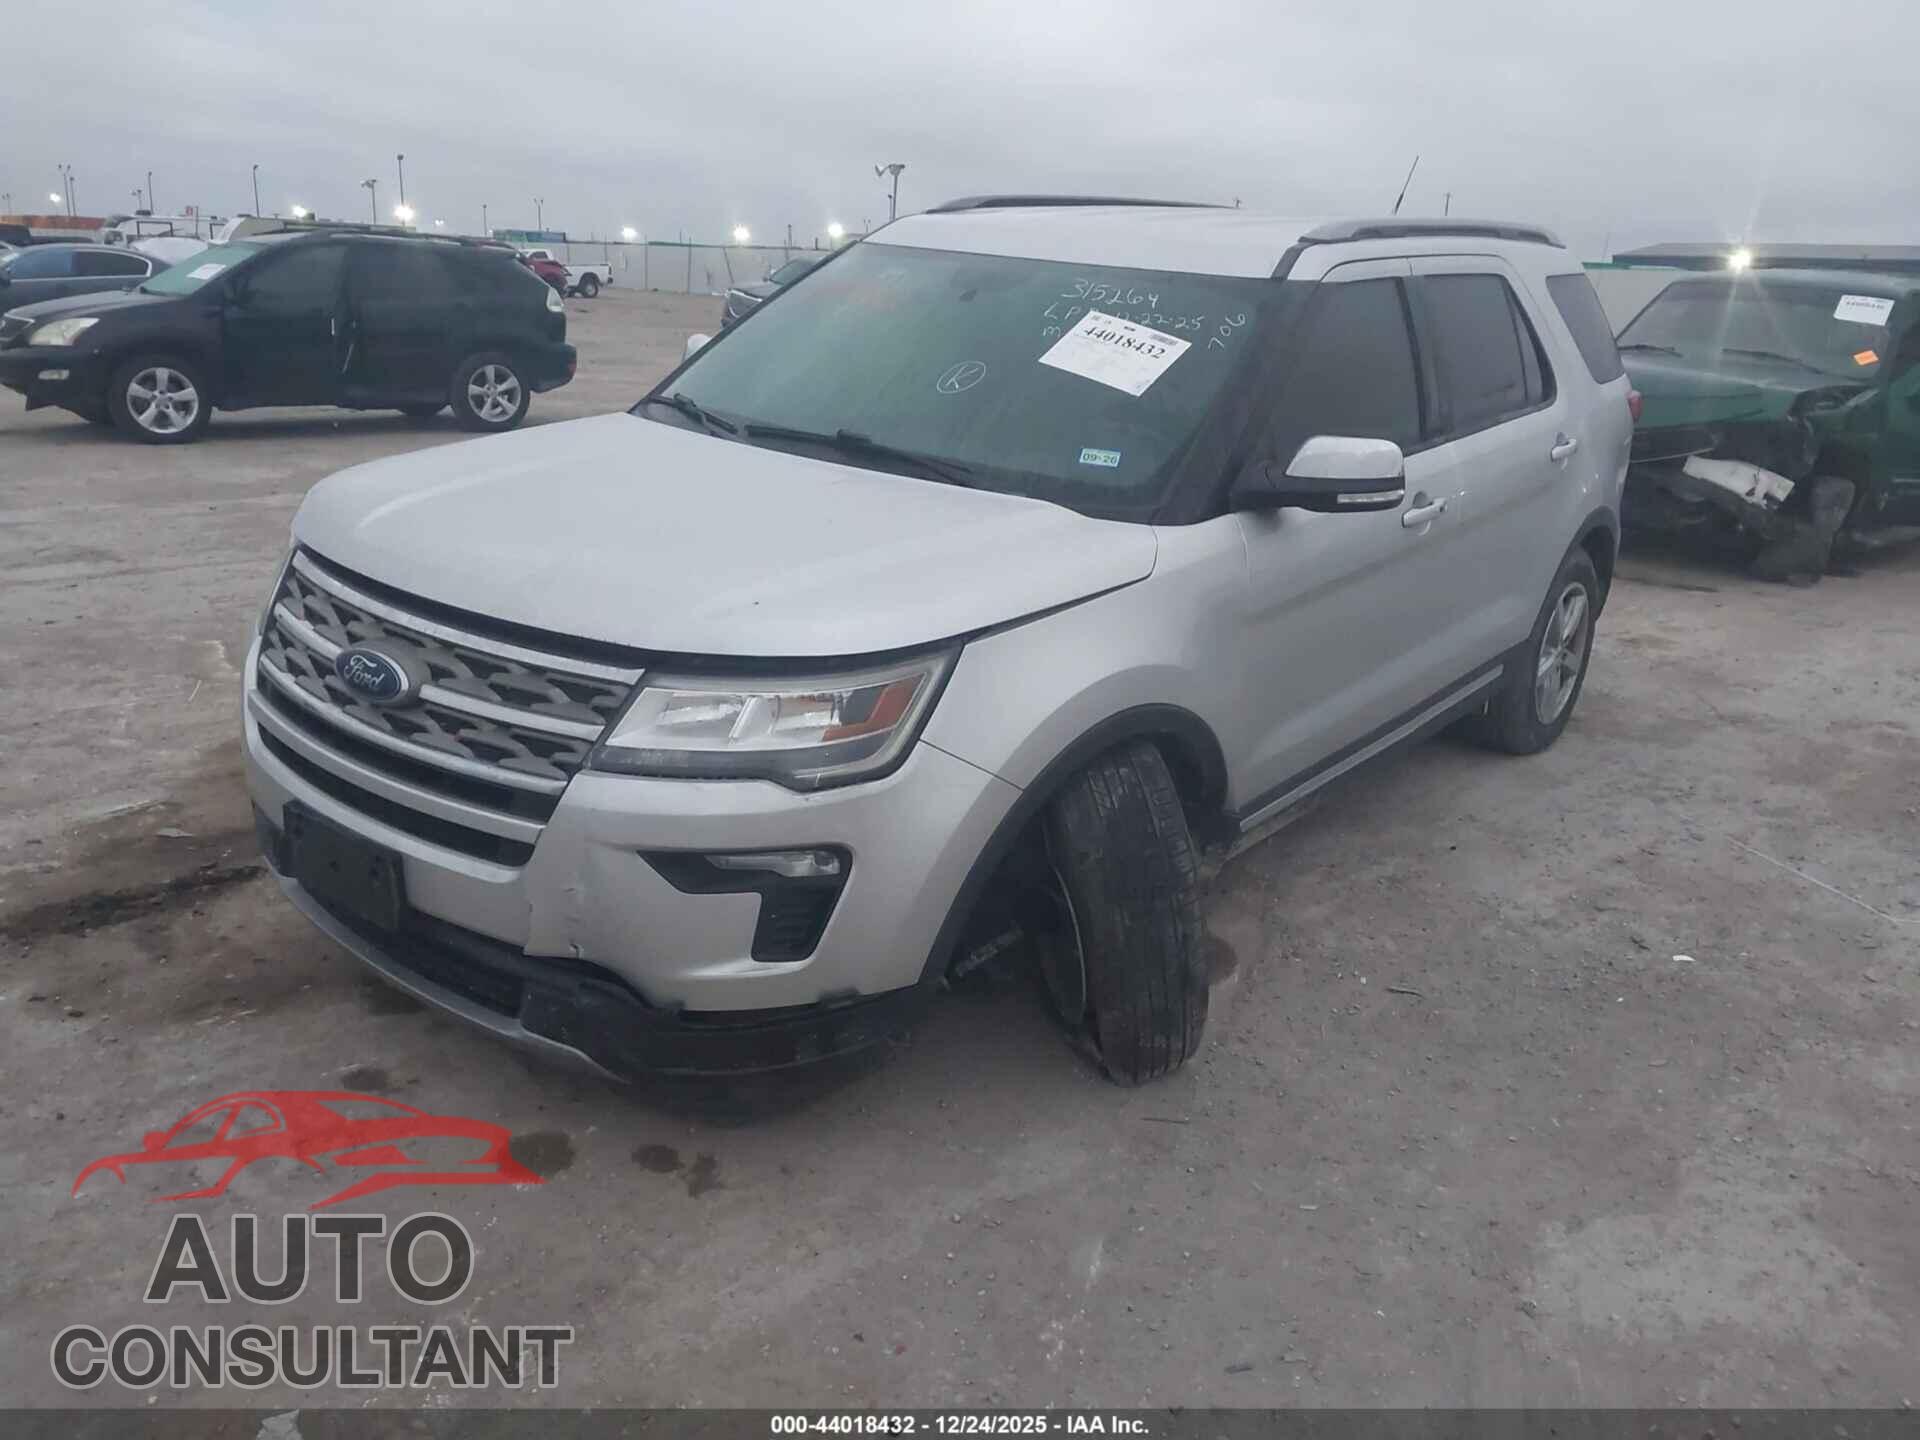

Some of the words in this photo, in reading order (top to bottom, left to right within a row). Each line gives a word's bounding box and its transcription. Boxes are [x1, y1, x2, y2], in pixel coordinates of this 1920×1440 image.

[1062, 279, 1159, 308] 315264
[1084, 326, 1166, 359] 44018432
[343, 654, 385, 688] Ford
